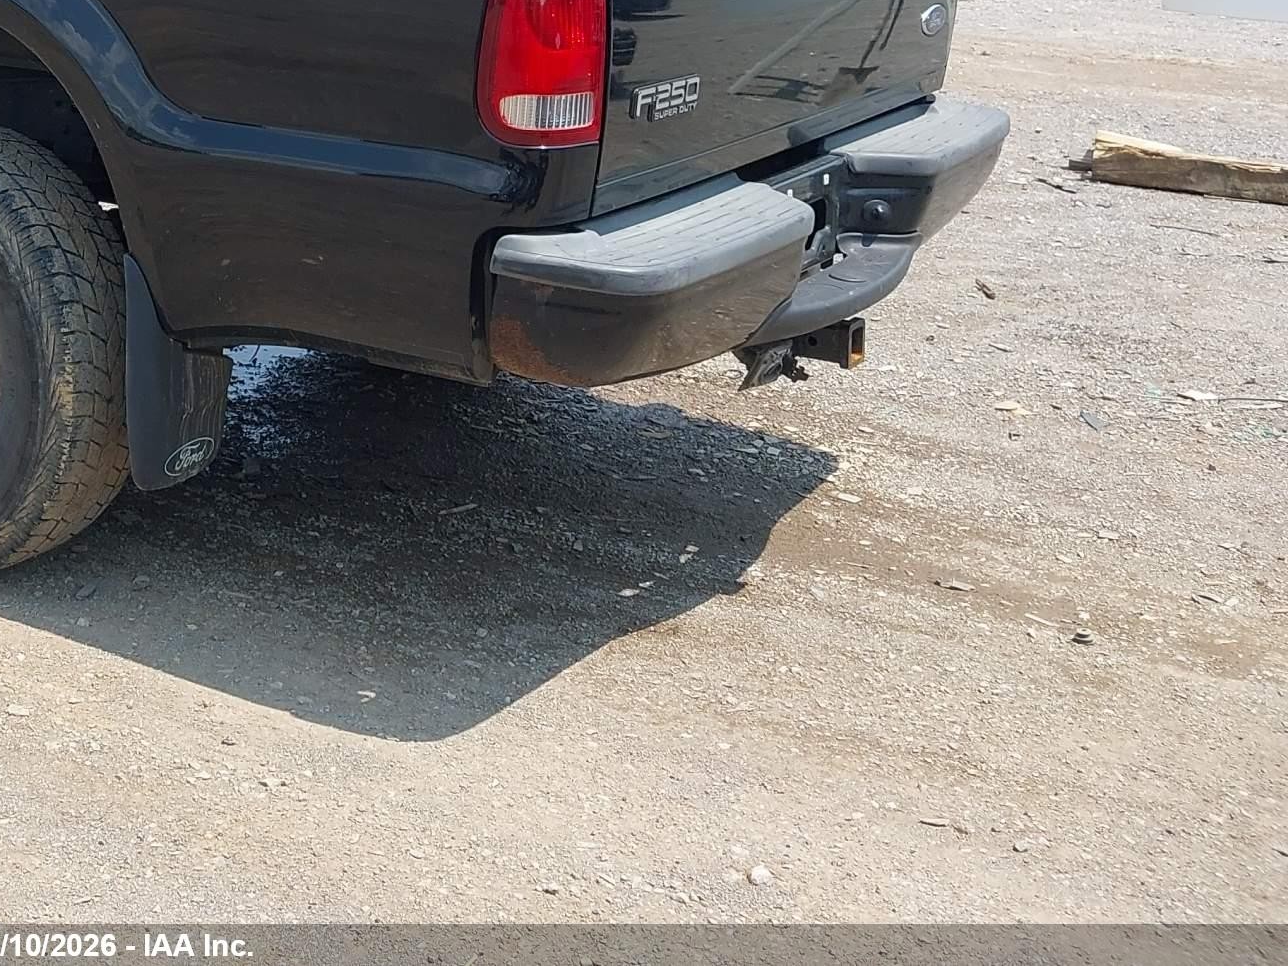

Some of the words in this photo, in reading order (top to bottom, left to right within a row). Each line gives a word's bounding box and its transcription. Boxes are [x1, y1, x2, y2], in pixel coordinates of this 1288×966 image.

[636, 76, 700, 117] F250
[654, 106, 678, 121] SUPER
[679, 101, 698, 114] DUTY
[174, 442, 207, 471] Ford
